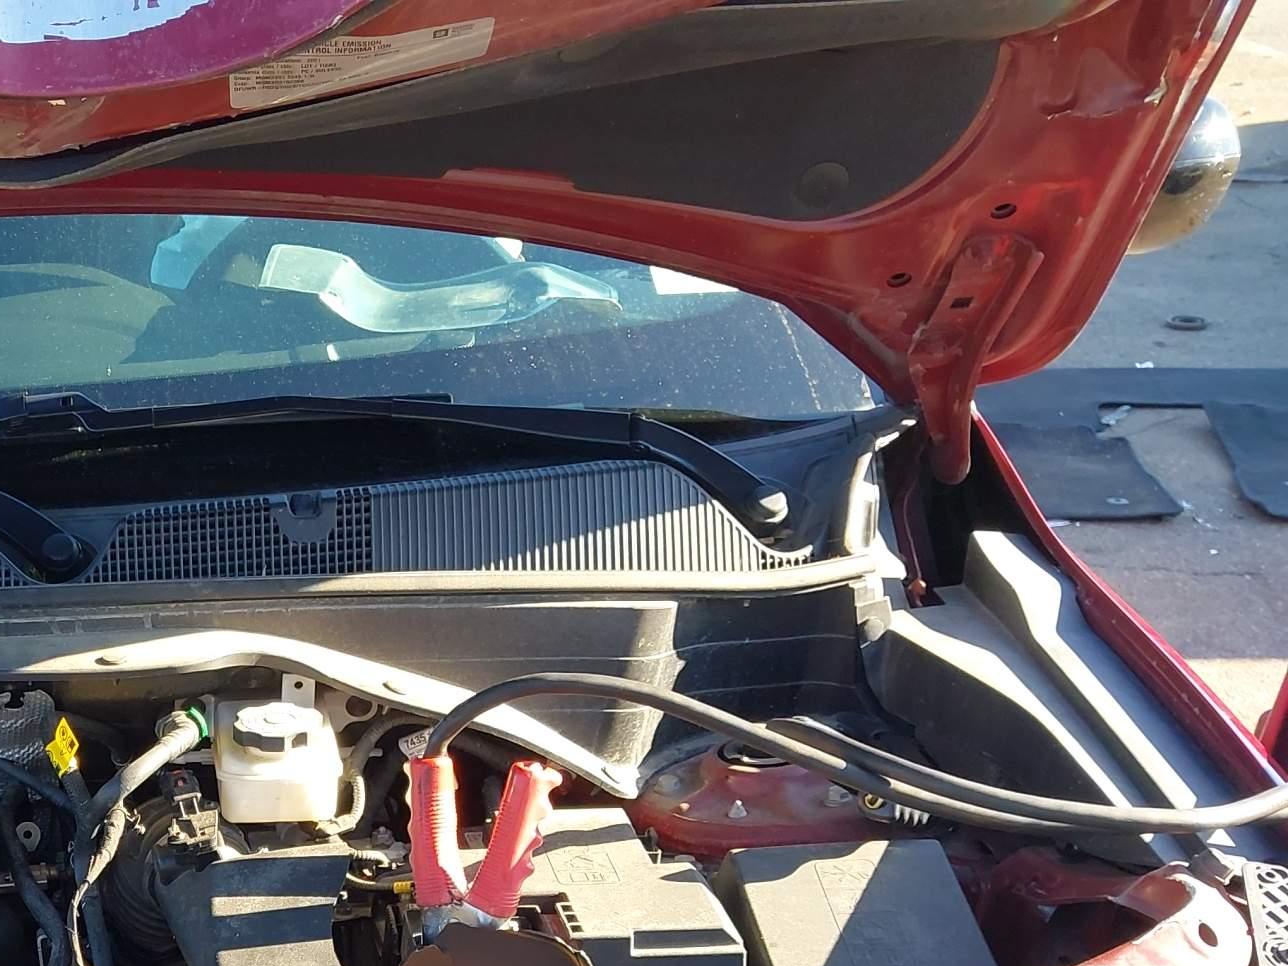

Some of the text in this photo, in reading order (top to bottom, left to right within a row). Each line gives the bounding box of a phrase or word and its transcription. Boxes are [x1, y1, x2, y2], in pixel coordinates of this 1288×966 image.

[342, 38, 382, 48] EMISSION
[304, 43, 392, 54] NTROL INFORMATION
